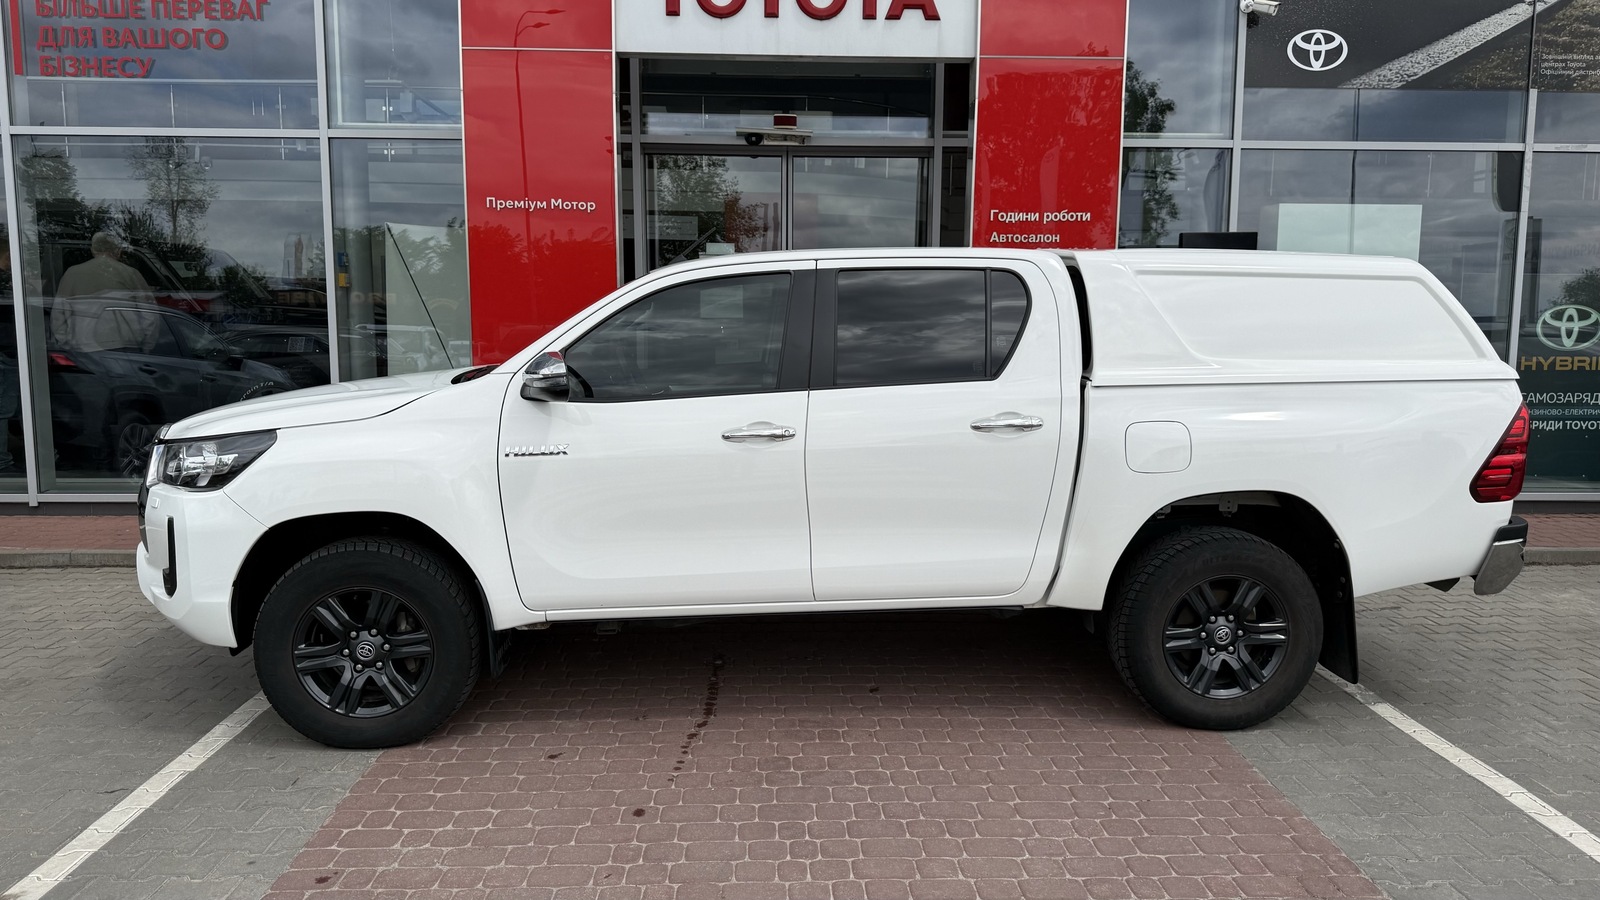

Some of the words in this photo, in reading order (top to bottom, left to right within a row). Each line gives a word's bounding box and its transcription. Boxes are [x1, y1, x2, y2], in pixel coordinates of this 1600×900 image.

[35, 0, 143, 18] БІЛЬШЕ
[151, 0, 268, 20] ПЕРЕВАГ
[37, 26, 95, 50] ДЛЯ
[102, 27, 228, 49] ВАШОГО
[39, 56, 152, 77] БІЗНЕСУ
[486, 197, 547, 212] Преміум
[551, 199, 596, 213] Мотор
[990, 209, 1039, 223] Години
[1043, 210, 1091, 224] роботи
[990, 231, 1060, 243] Автосалон
[1521, 356, 1600, 371] HYBRI
[505, 444, 569, 457] HILUX
